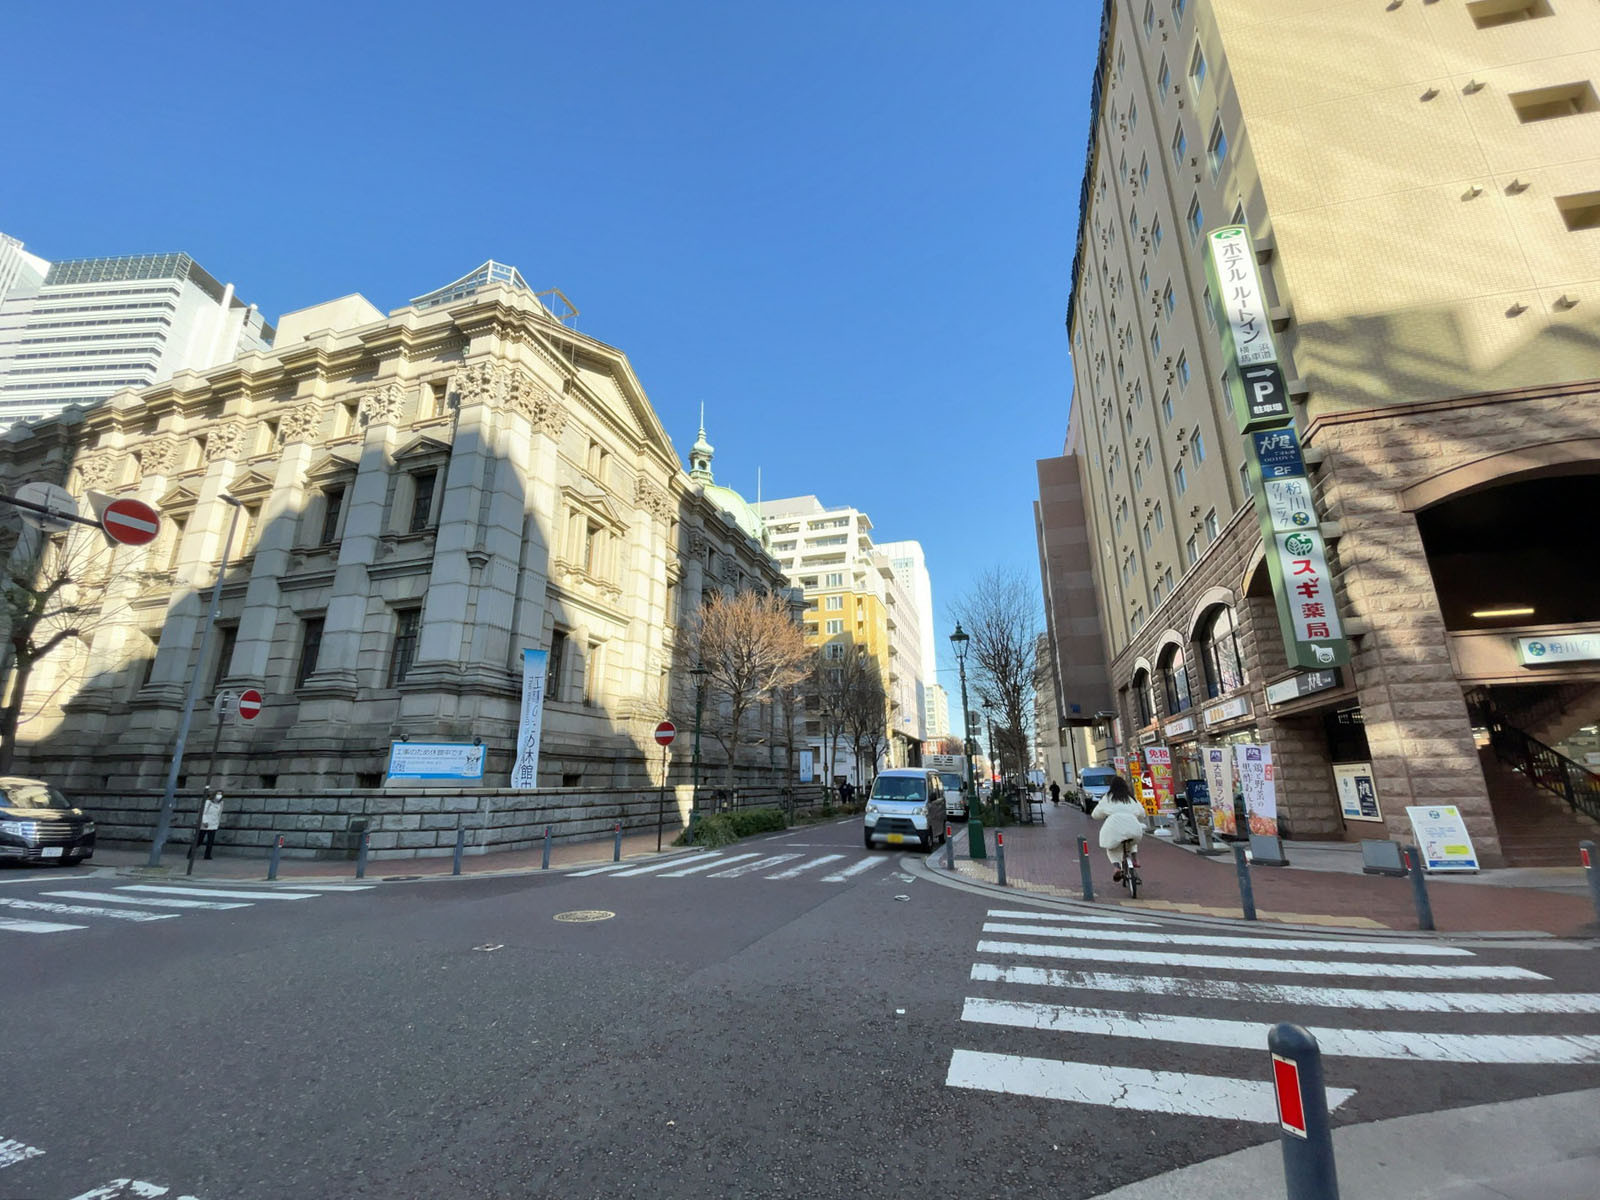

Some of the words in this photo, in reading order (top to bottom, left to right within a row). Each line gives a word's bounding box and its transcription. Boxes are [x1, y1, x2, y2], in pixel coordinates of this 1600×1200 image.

[1253, 381, 1274, 403] P
[1253, 402, 1284, 415] 駐車場
[1260, 434, 1294, 455] 大戸屋
[1273, 466, 1292, 476] 2F
[1272, 482, 1288, 528] クリニック
[1285, 480, 1307, 511] 粉川
[1292, 558, 1330, 640] スギ薬局
[1148, 749, 1169, 759] 免税
